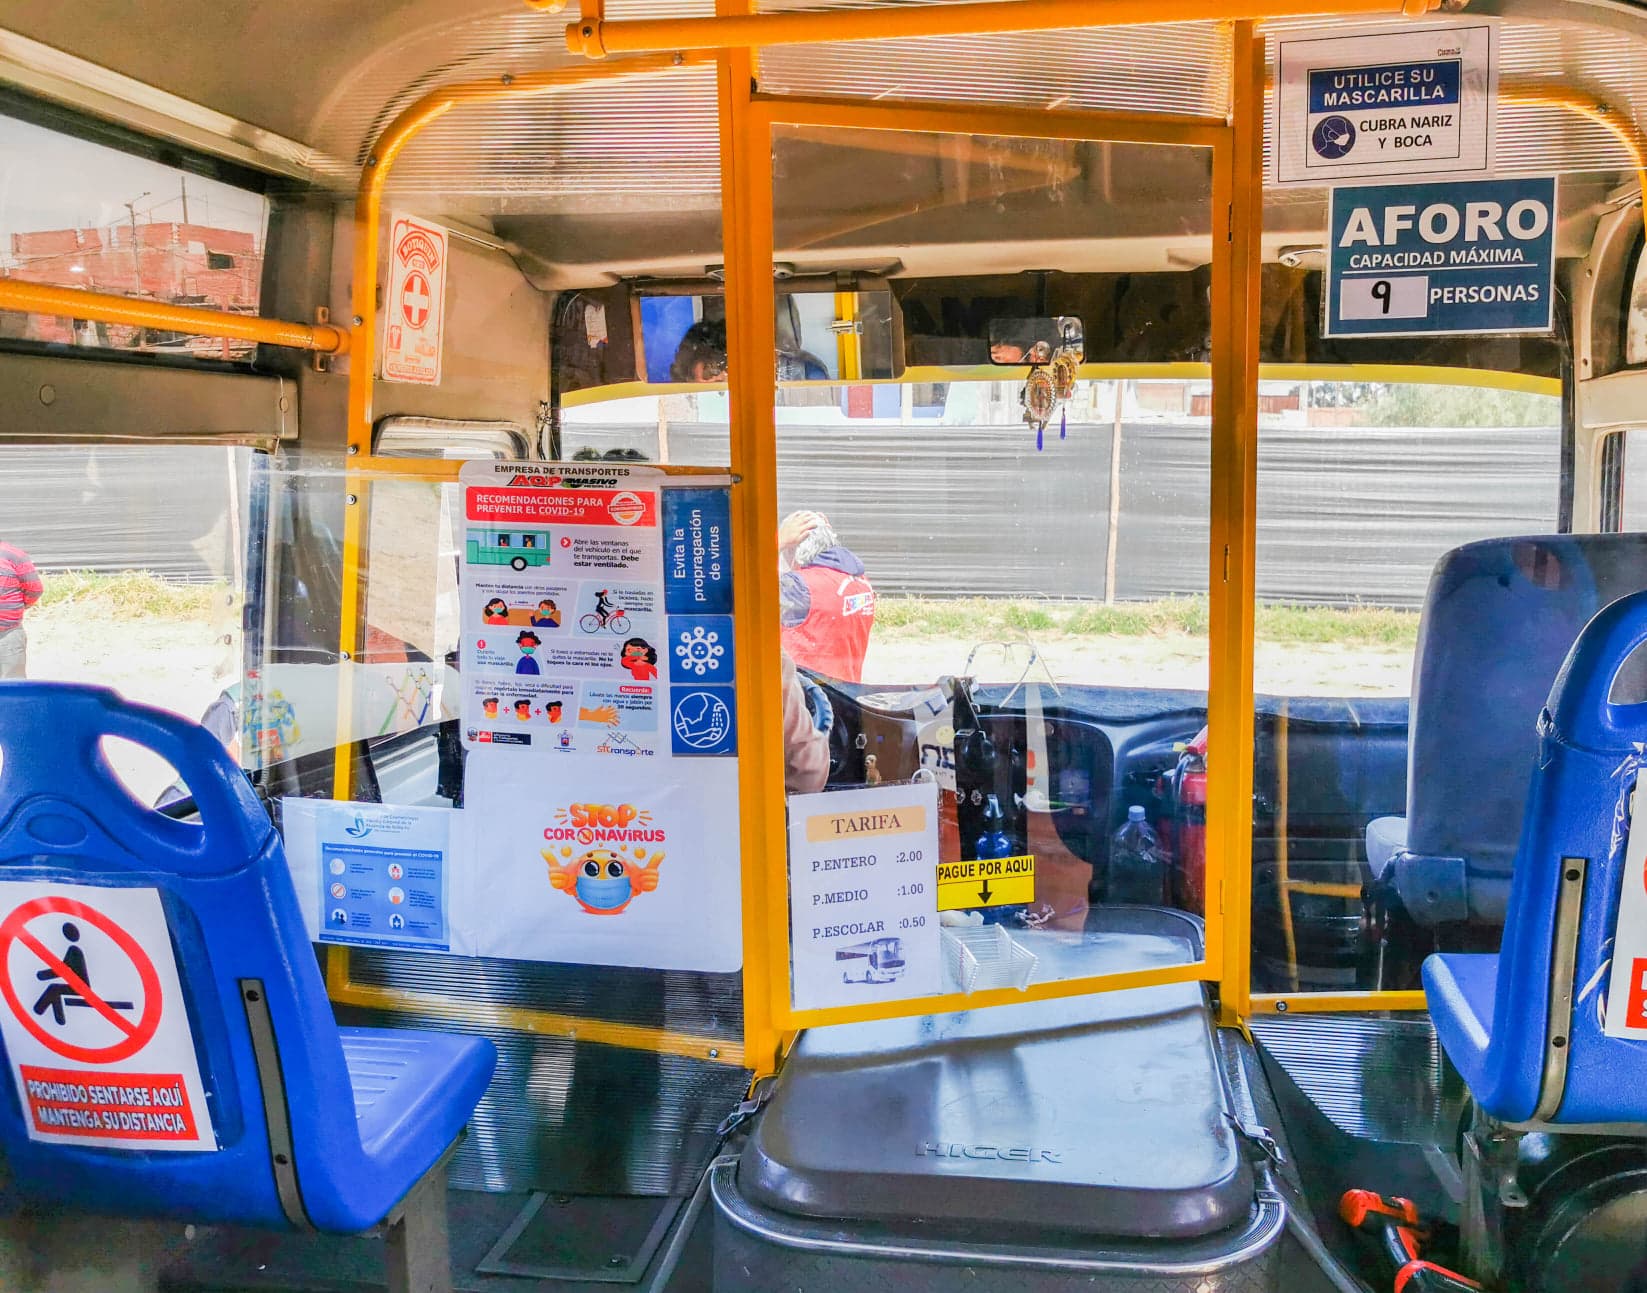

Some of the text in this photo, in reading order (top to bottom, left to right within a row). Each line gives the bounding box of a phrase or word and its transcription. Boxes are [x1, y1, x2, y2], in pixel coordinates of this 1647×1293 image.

[1334, 69, 1434, 89] UTILICE SU
[1324, 84, 1444, 106] MASCARILLA
[1360, 114, 1452, 132] CUBRA NARIZ
[1378, 134, 1432, 149] Y BOCA
[1338, 200, 1548, 248] AFORO
[1350, 246, 1524, 268] CAPACIDAD MÁXIMA
[1371, 280, 1392, 314] 9
[1430, 284, 1540, 304] PERSONAS
[494, 465, 630, 476] EMPRESA DE TRANSPORTES
[476, 494, 603, 507] RECOMENDACIONES PARA
[476, 505, 523, 514] PREVENIR
[539, 506, 584, 516] COVID-19
[672, 528, 686, 578] Evita la
[690, 509, 706, 601] propragación
[708, 526, 720, 580] de virus
[570, 803, 637, 828] STOP
[831, 814, 902, 834] TARIFA
[812, 850, 922, 872] P.ENTERO :2.00
[938, 858, 1032, 880] PAGUE POR AQUI
[812, 883, 924, 905] P.MEDIO :1.00
[812, 916, 926, 938] P.ESCOLAR :0.50
[27, 1079, 184, 1106] PROHIBIDO SENTARSE AQUÍ
[38, 1106, 186, 1134] MANTENGA SU DISTANCIA
